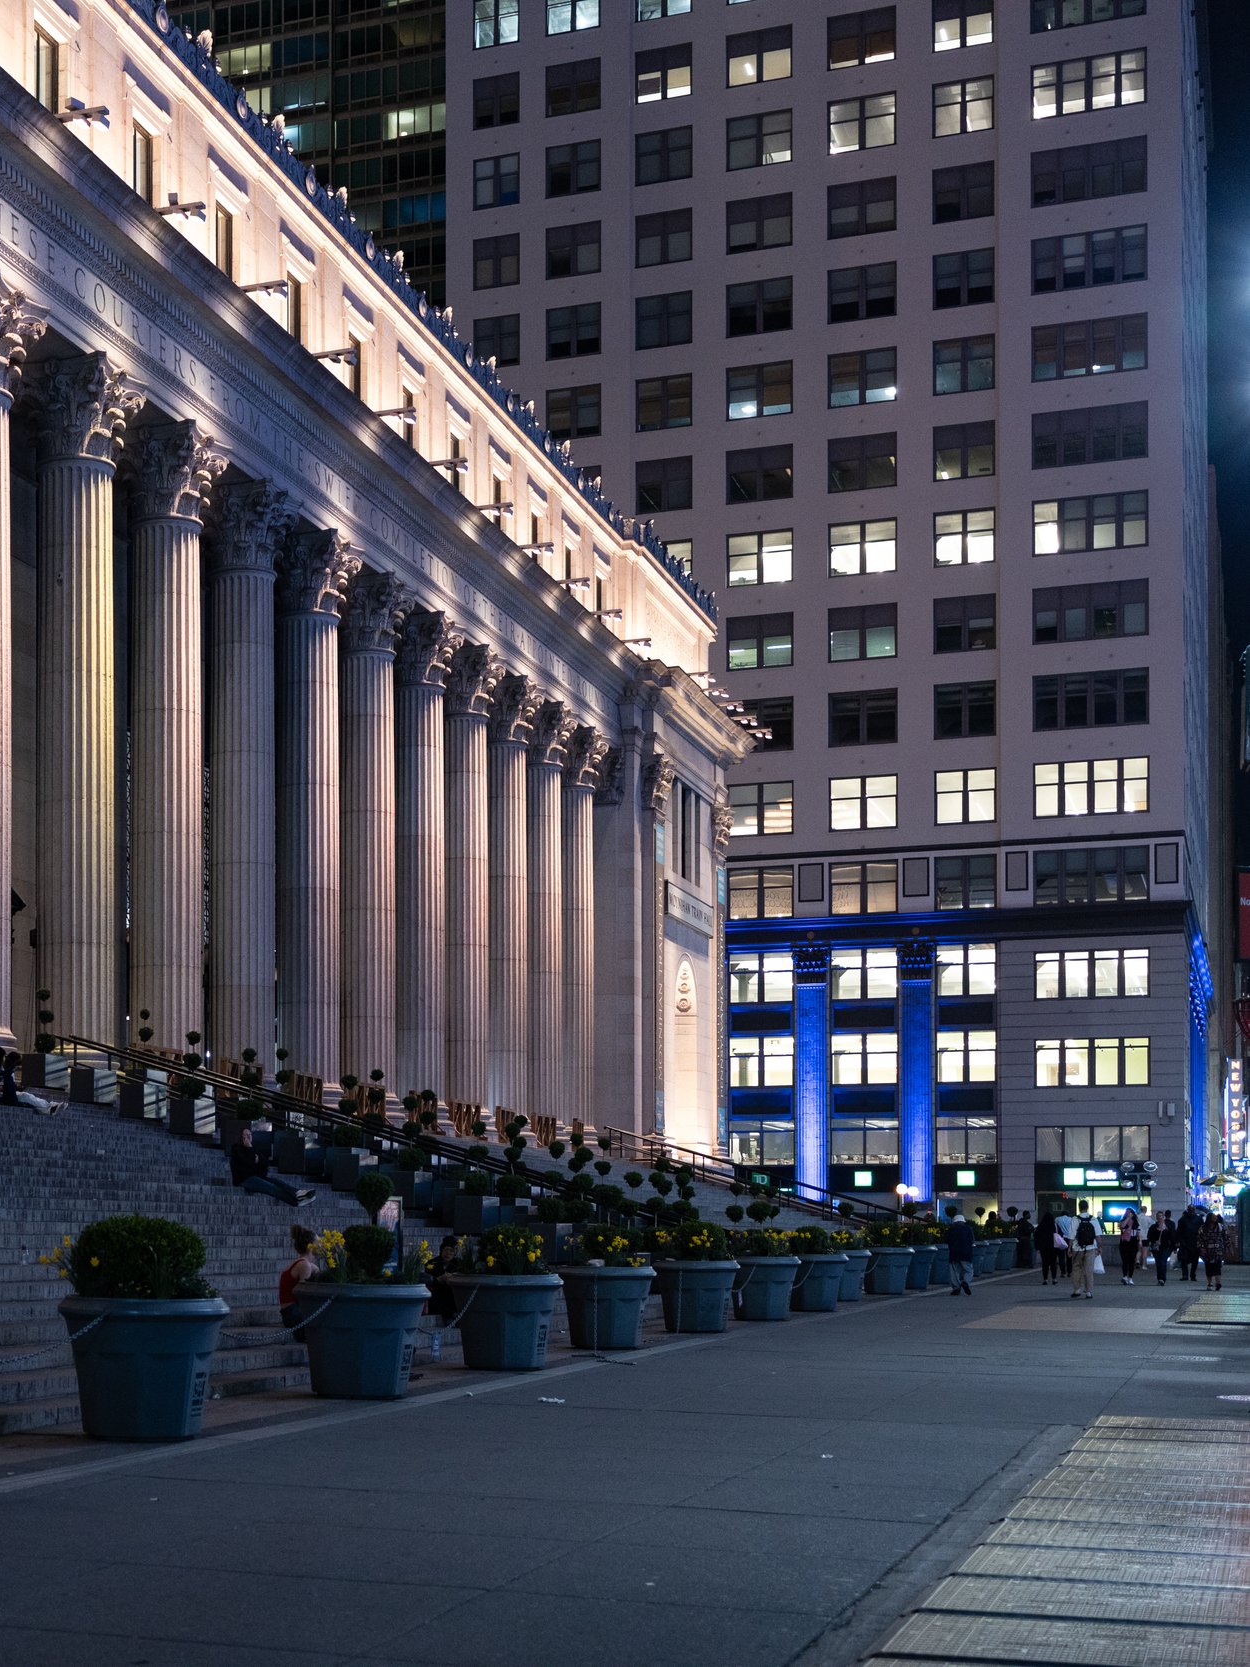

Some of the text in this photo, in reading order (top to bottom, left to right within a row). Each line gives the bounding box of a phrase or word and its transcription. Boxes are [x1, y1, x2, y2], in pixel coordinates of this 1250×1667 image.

[74, 267, 197, 388] COURIERS
[209, 374, 262, 437] FROM
[272, 427, 304, 473] THE
[313, 461, 363, 514] SWIFT
[369, 508, 458, 594] COMPLETION
[463, 584, 478, 611] OF
[482, 598, 518, 643] THEIR
[691, 905, 703, 921] TRAIN
[1230, 1061, 1241, 1160] NEW YORKE
[753, 1174, 768, 1185] TD
[1086, 1170, 1117, 1180] Bank
